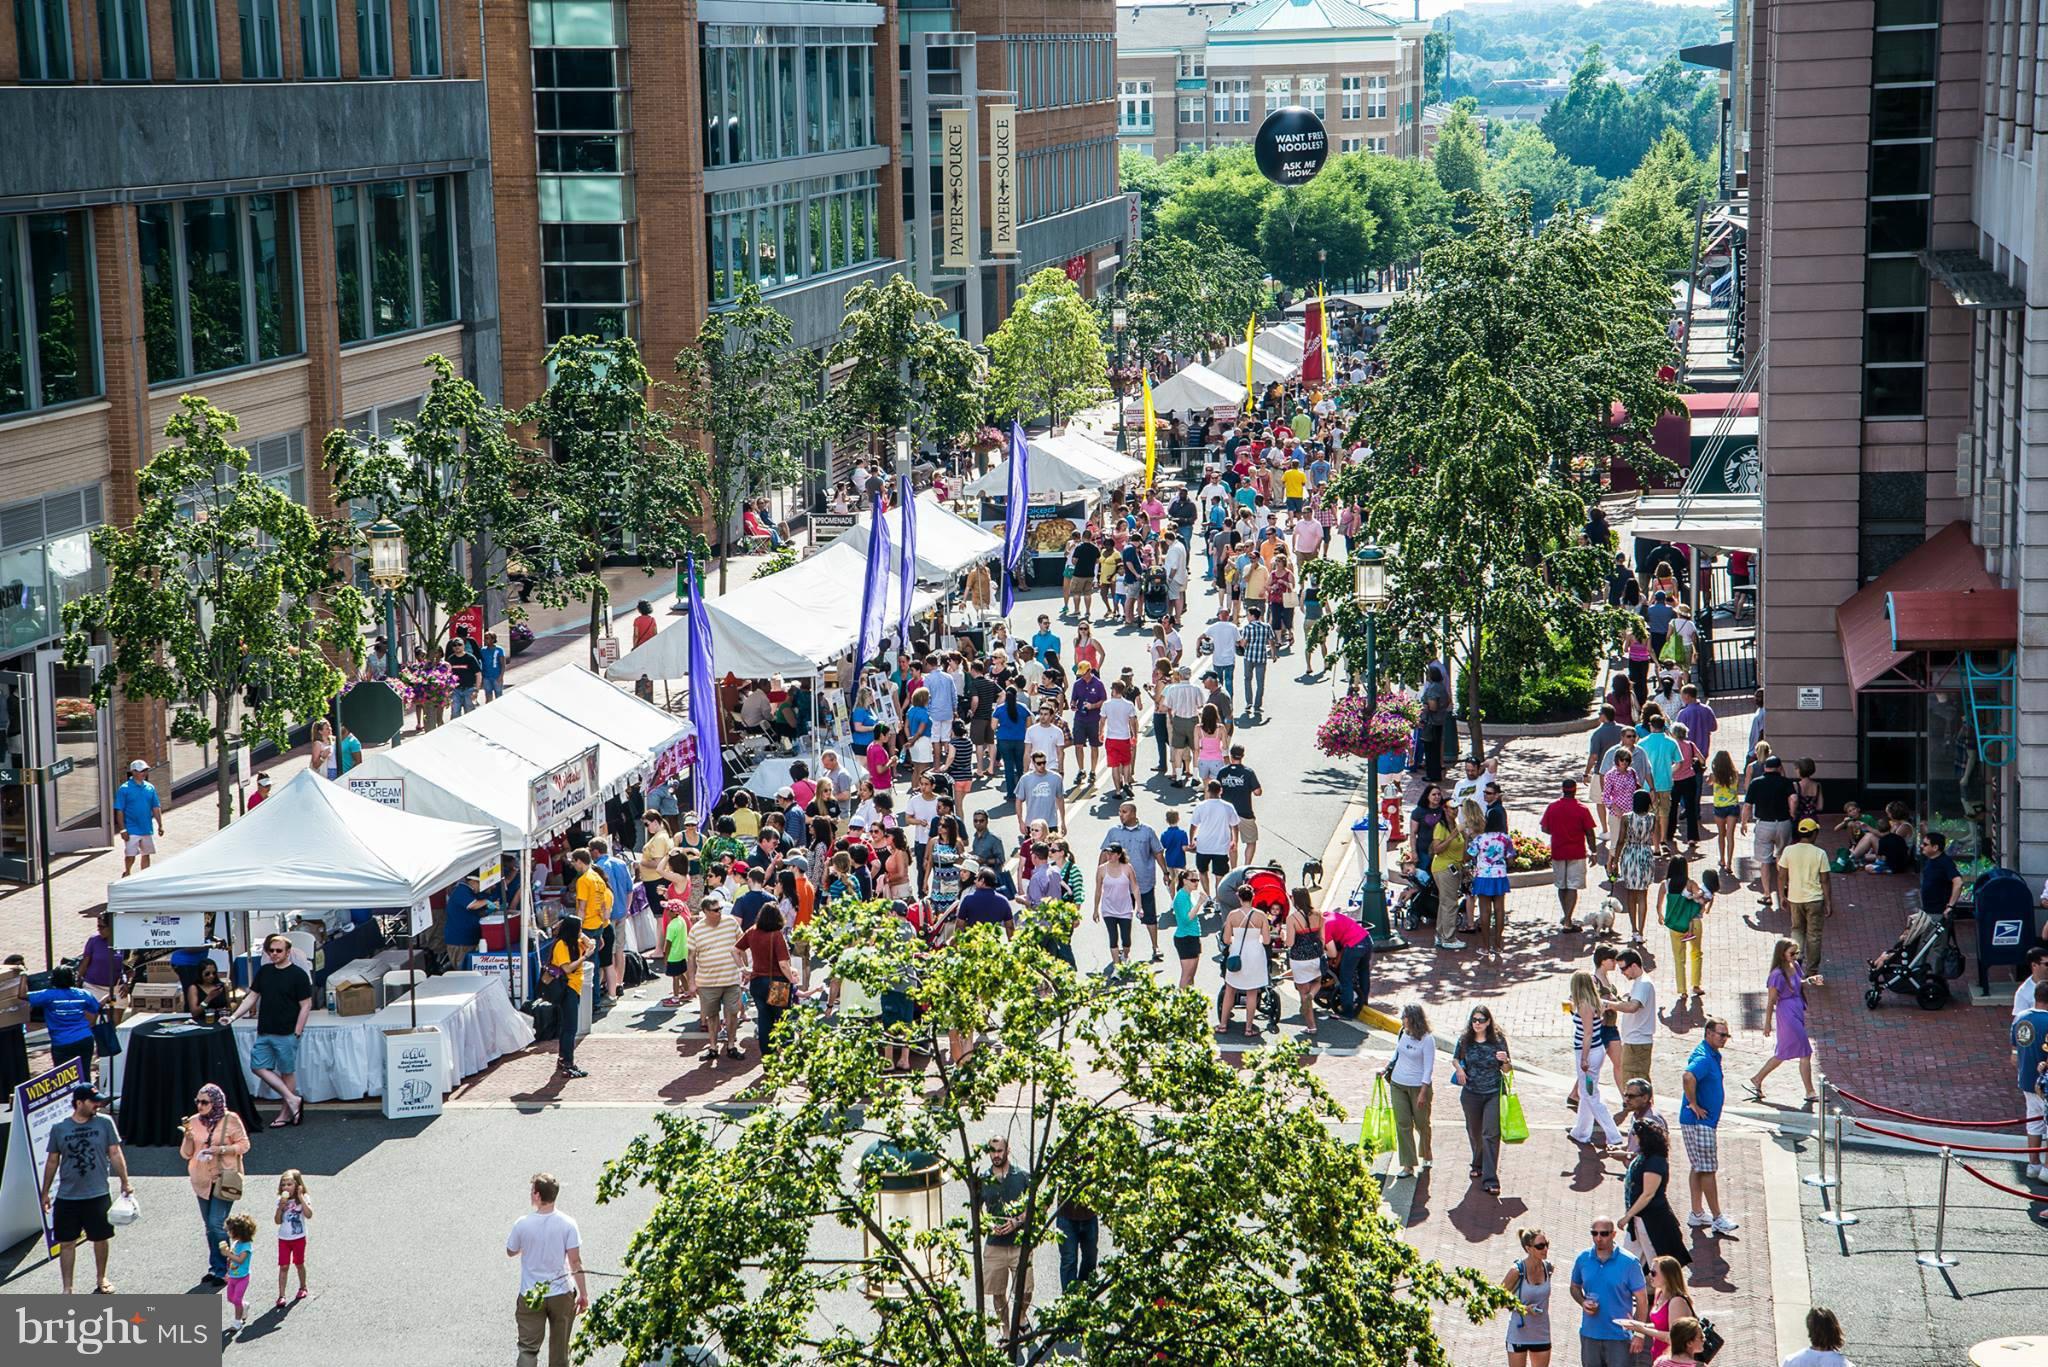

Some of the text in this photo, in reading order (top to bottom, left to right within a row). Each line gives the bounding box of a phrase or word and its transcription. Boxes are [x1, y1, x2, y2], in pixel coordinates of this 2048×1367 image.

[1275, 133, 1305, 143] WANT
[1278, 141, 1324, 152] NOODLES?
[1283, 160, 1316, 171] ASK ME
[996, 119, 1010, 243] PAPER SOURCE
[949, 125, 963, 257] PAPER SOURCE
[816, 516, 852, 524] PROMENADE
[0, 770, 12, 781] St.
[369, 788, 402, 797] CREAM
[151, 929, 171, 937] Wine
[145, 939, 150, 947] 6
[26, 1078, 52, 1100] WINE
[57, 1065, 79, 1085] DINE
